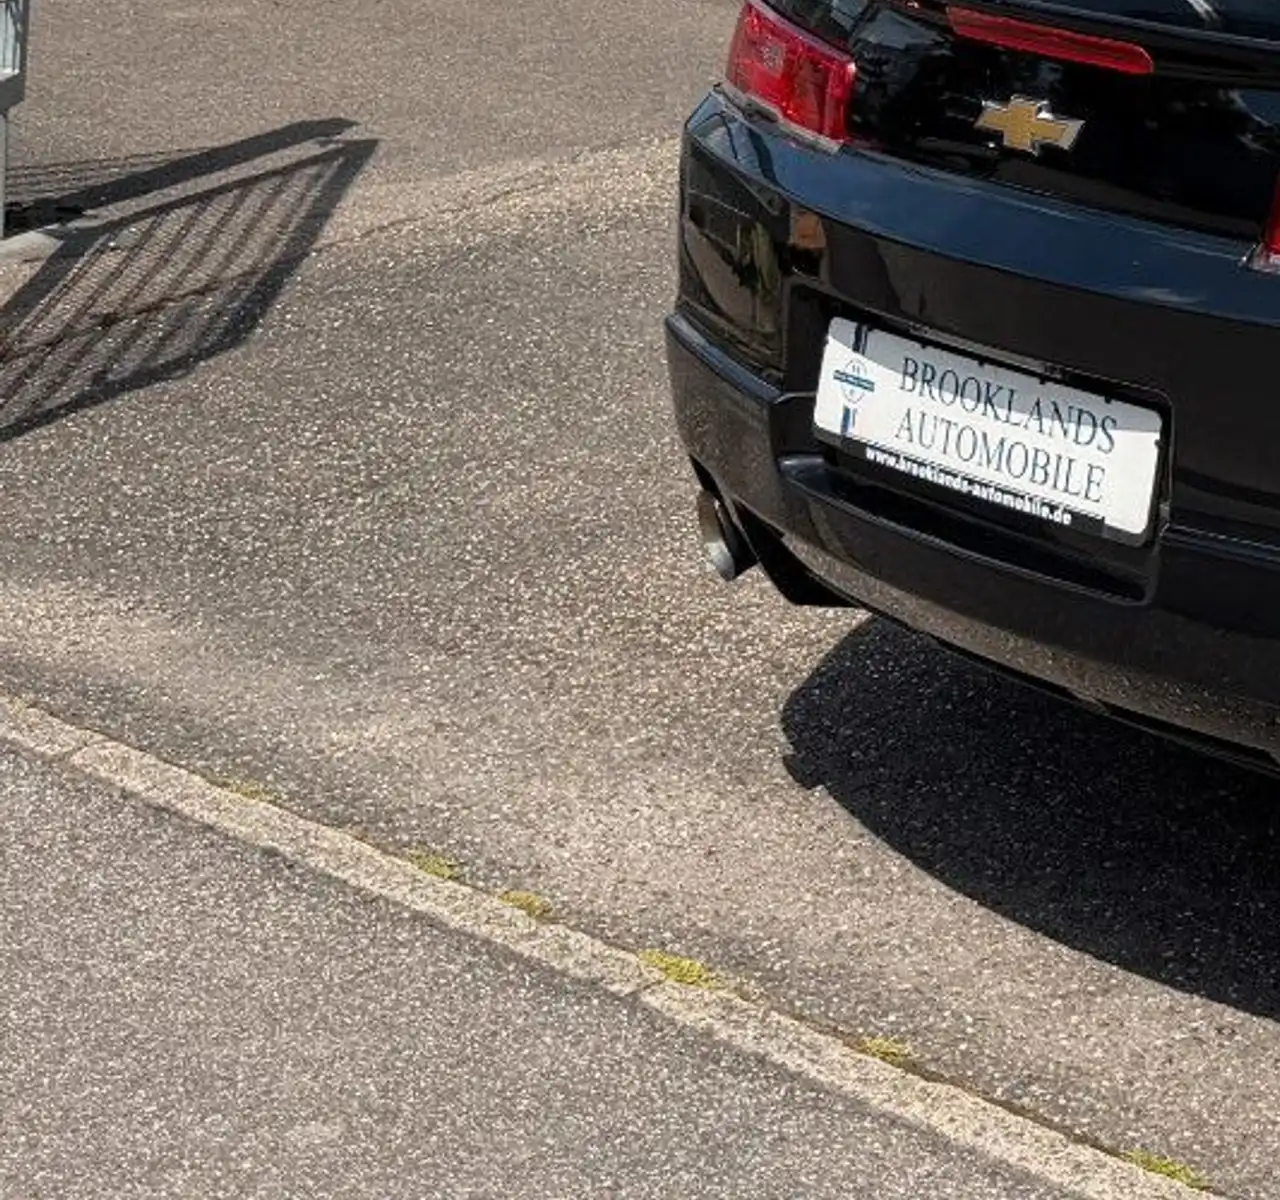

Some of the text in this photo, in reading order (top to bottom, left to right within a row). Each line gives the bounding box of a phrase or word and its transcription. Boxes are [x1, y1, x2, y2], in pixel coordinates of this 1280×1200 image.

[899, 356, 1117, 454] BROOKLANDS
[865, 446, 1072, 526] www.brooklands-automobile.de
[896, 407, 1106, 504] AUTOMOBILE
